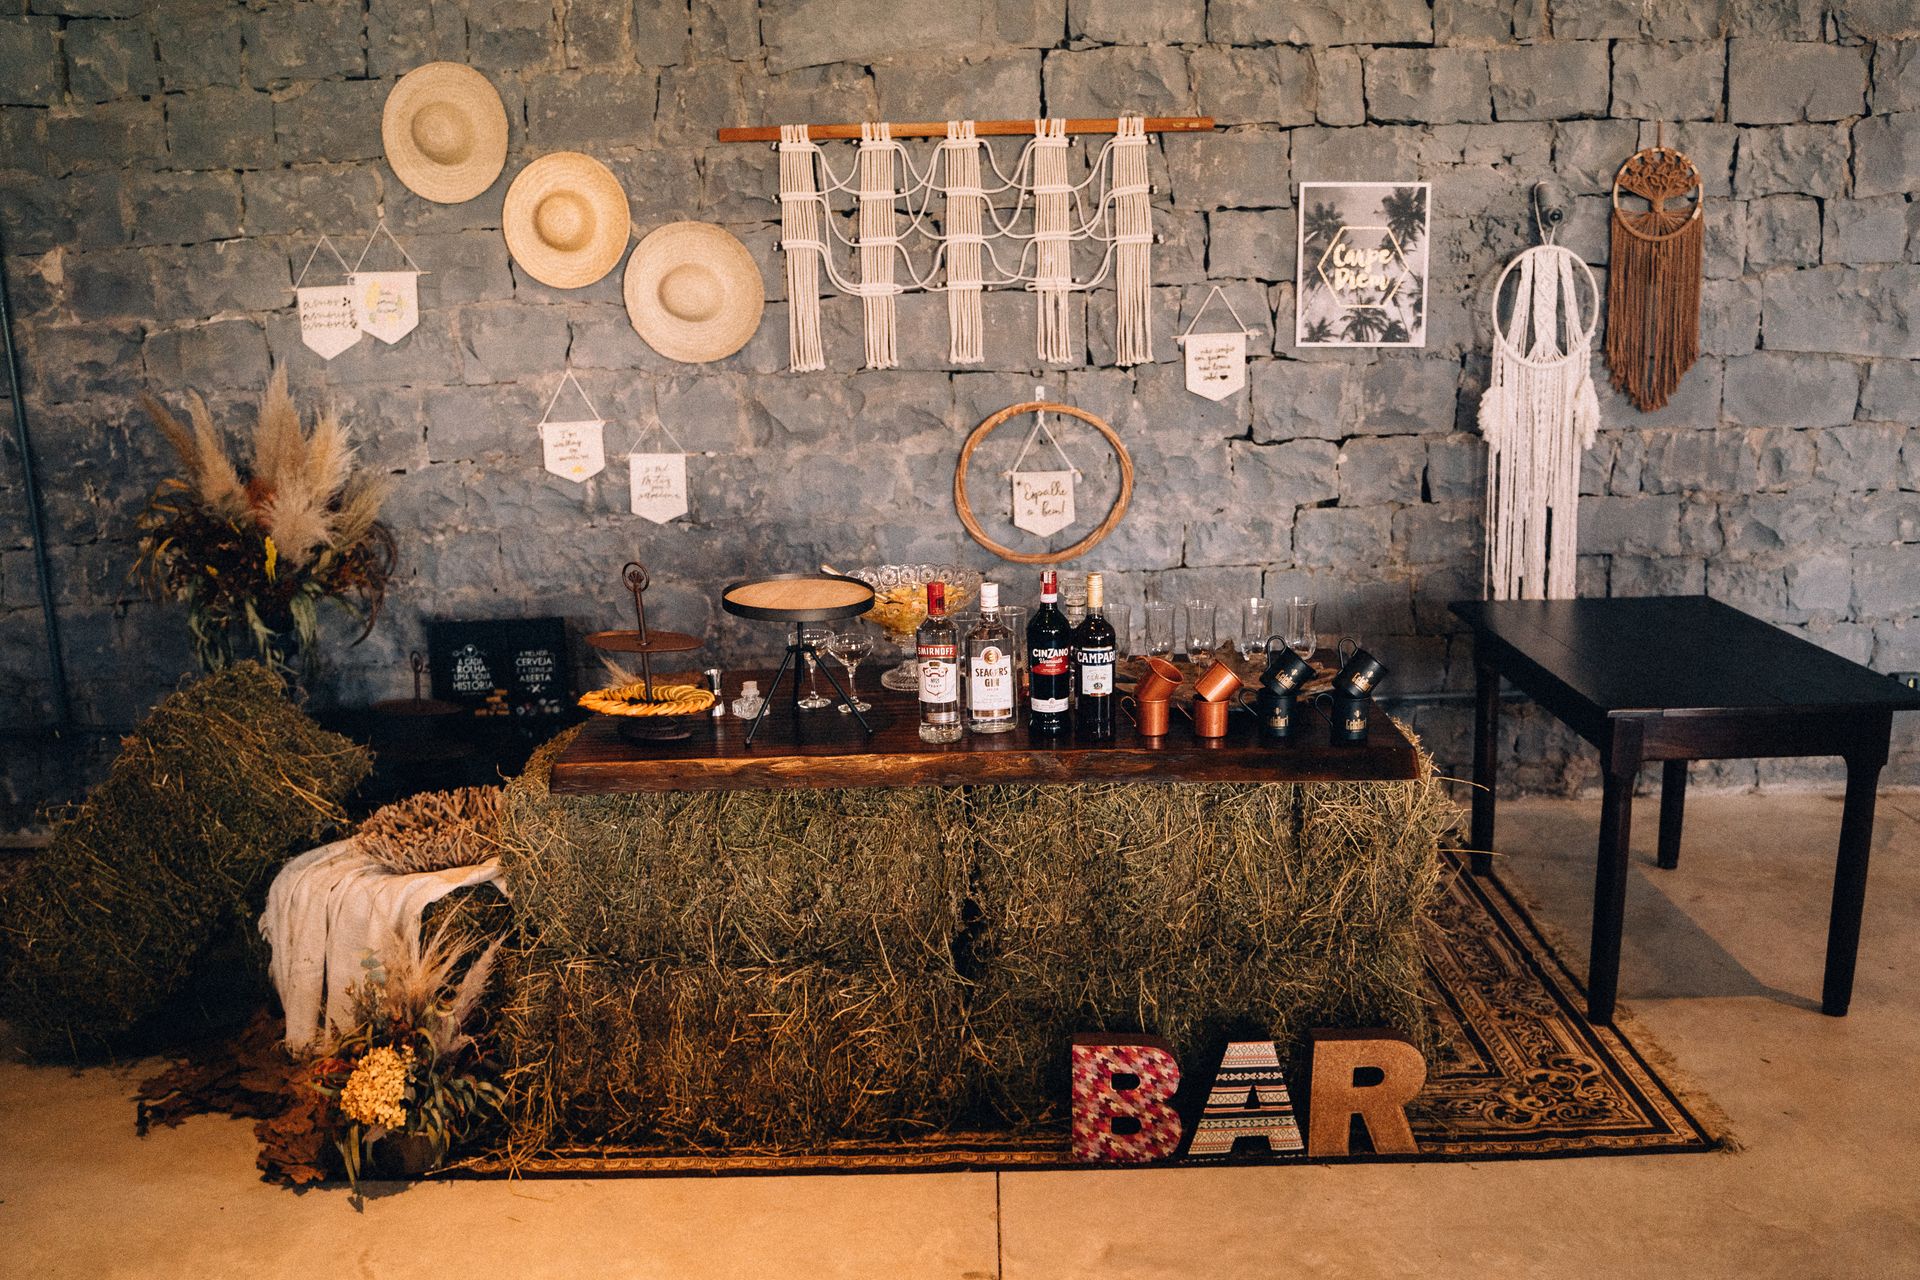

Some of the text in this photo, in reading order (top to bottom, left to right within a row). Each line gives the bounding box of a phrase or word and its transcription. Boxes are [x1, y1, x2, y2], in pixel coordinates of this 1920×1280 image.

[1333, 243, 1395, 275] Carpe
[1334, 267, 1390, 291] Diem
[1024, 480, 1067, 505] Espalhe
[918, 647, 954, 656] SMIRNOFF
[1032, 648, 1069, 659] CINZANO
[464, 657, 484, 665] CADA
[515, 657, 553, 666] CERVEJA
[1077, 650, 1116, 664] CAMPARI
[456, 665, 487, 674] ROLHA
[453, 673, 470, 681] UMA
[519, 673, 552, 682] ABERTA
[984, 678, 1000, 688] GIN
[1072, 1039, 1428, 1162] BAR
